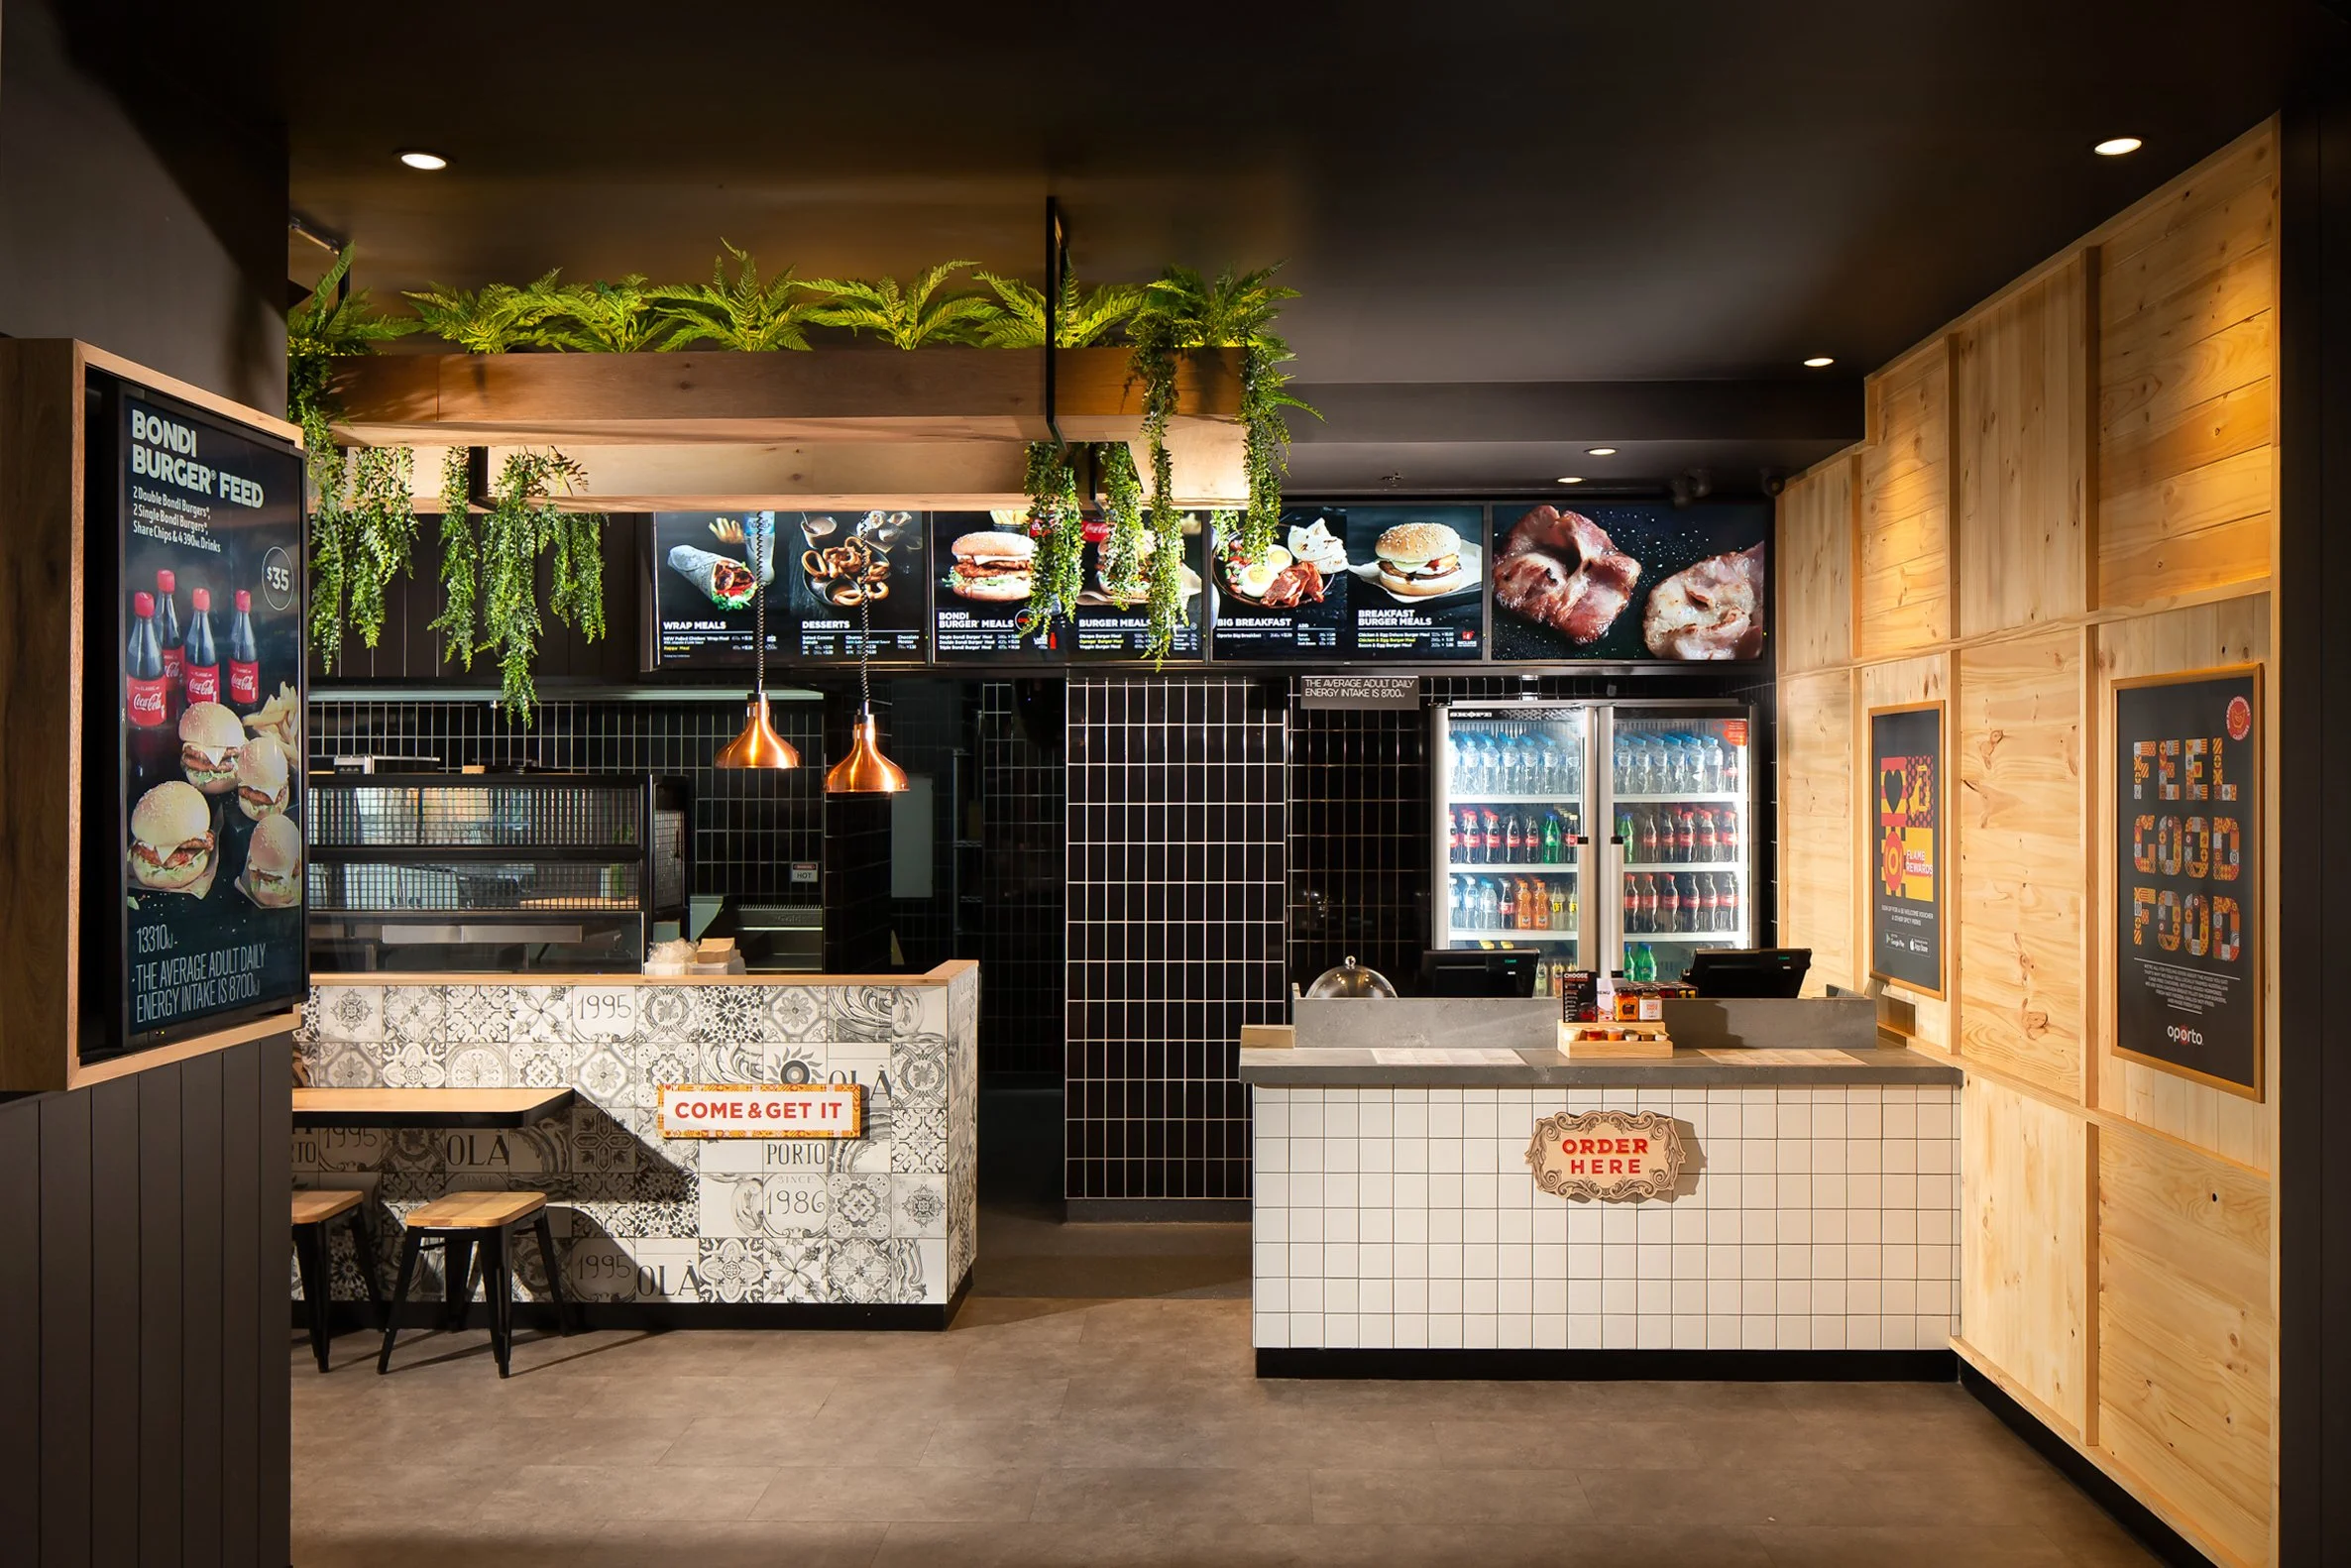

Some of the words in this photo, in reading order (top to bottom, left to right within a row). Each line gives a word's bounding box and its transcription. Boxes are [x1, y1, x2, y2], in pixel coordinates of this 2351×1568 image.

[132, 409, 196, 457] BONDI
[133, 486, 138, 499] 2
[139, 487, 162, 505] Double
[163, 494, 181, 510] Bondi
[219, 472, 265, 508] FEED
[133, 504, 138, 515] 2
[139, 504, 159, 523] Single
[160, 509, 179, 526] Bondi
[133, 520, 154, 536] Share
[154, 525, 171, 543] Chips
[172, 530, 178, 542] &
[200, 536, 221, 552] Drinks
[267, 567, 289, 592] $35
[1304, 688, 1339, 697] ENERGY
[1341, 688, 1370, 698] INTAKE
[1372, 689, 1380, 698] IS
[1323, 679, 1361, 688] AVERAGE
[1363, 679, 1390, 688] ADULT
[1392, 679, 1414, 688] DAILY
[2134, 737, 2237, 801] FEEL
[1906, 849, 1926, 861] FLAME
[2134, 815, 2240, 881] GOOD
[1905, 861, 1934, 874] REWARDS
[2134, 887, 2240, 961] FOOD
[136, 961, 158, 991] THE
[160, 953, 206, 988] AVERAGE
[208, 947, 239, 978] ADULT
[240, 943, 267, 971] DAILY
[137, 987, 179, 1023] ENERGY
[181, 979, 216, 1012] INTAKE
[217, 977, 227, 1004] IS
[577, 994, 633, 1020] 1995
[2167, 1025, 2203, 1046] oporto
[821, 1102, 842, 1119] IT
[325, 1128, 378, 1149] 1995
[1562, 1139, 1649, 1155] ORDER
[766, 1144, 826, 1165] PORTO
[1571, 1159, 1641, 1175] HERE
[765, 1190, 826, 1214] 1986
[578, 1254, 631, 1280] 1995
